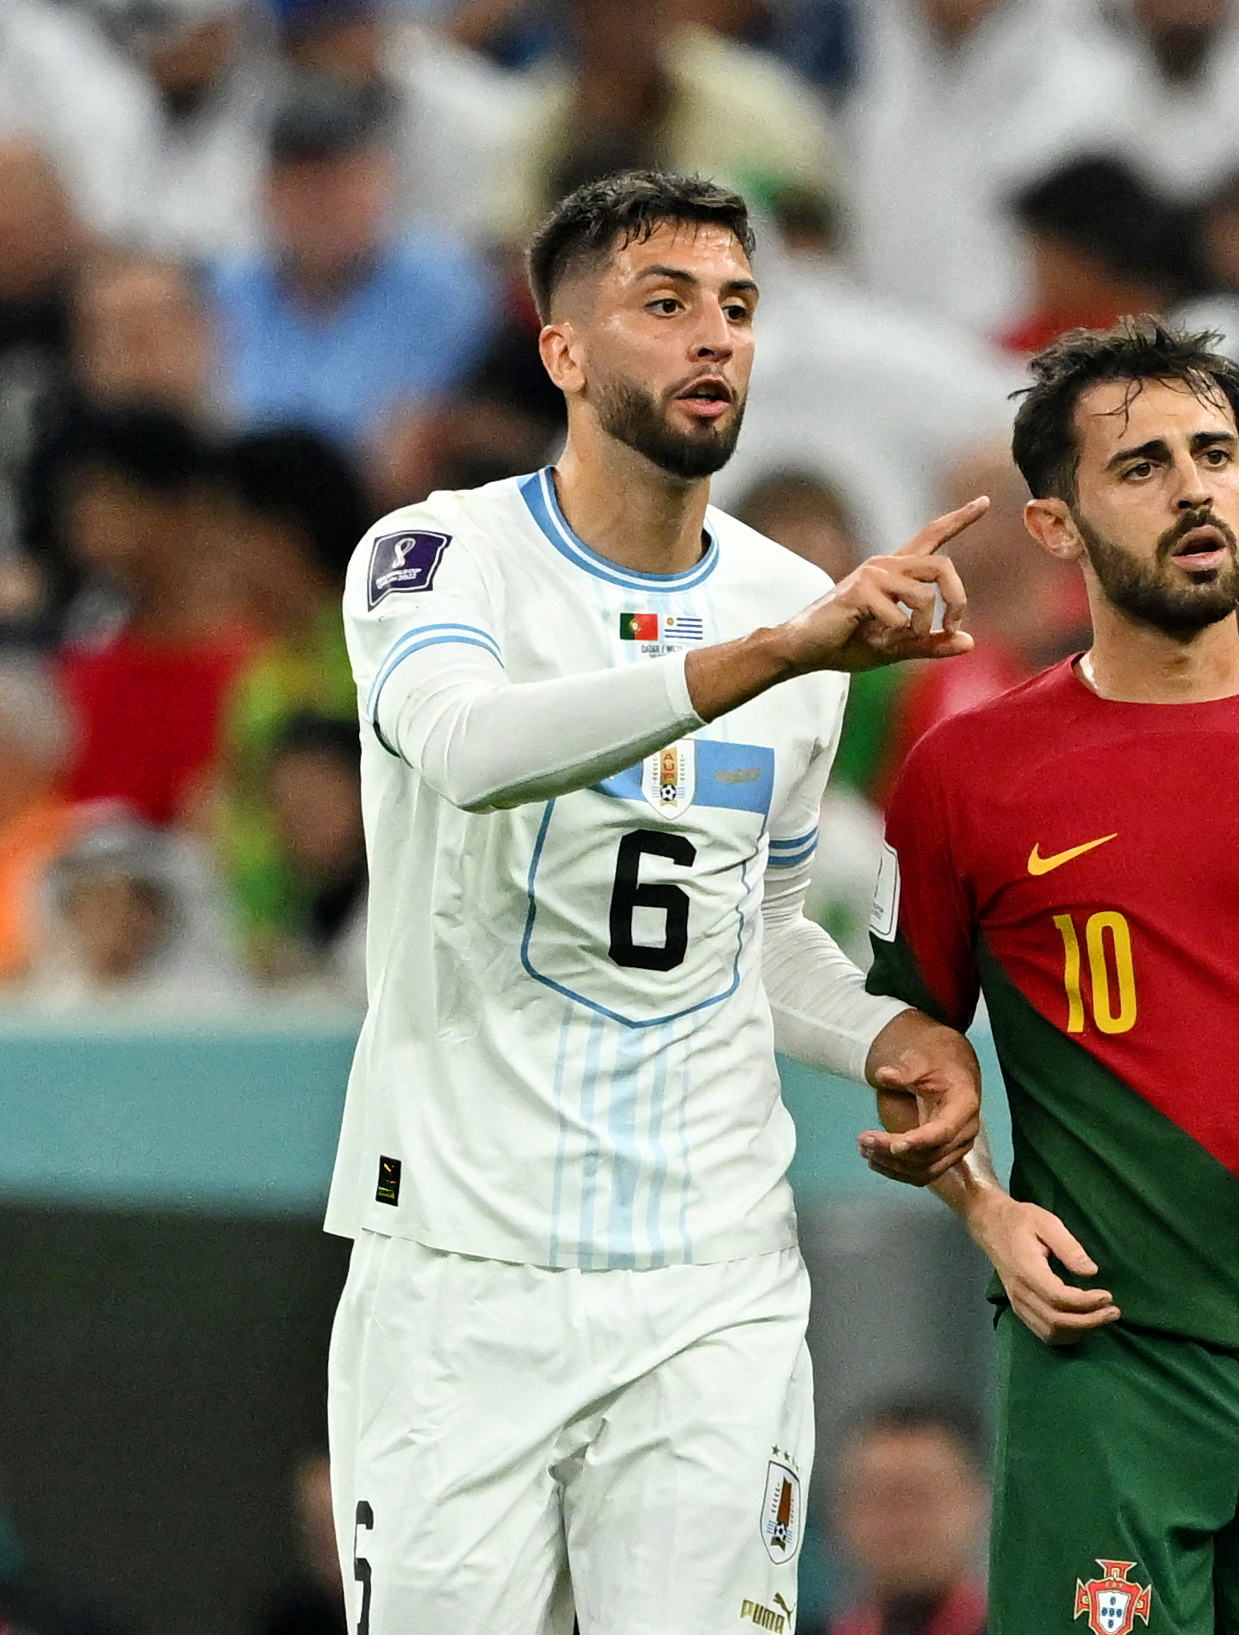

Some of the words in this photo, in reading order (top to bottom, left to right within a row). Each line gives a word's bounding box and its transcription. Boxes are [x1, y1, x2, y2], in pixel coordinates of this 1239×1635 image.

[608, 828, 697, 972] 6
[1052, 910, 1138, 1034] 10
[739, 1598, 786, 1635] PUMA
